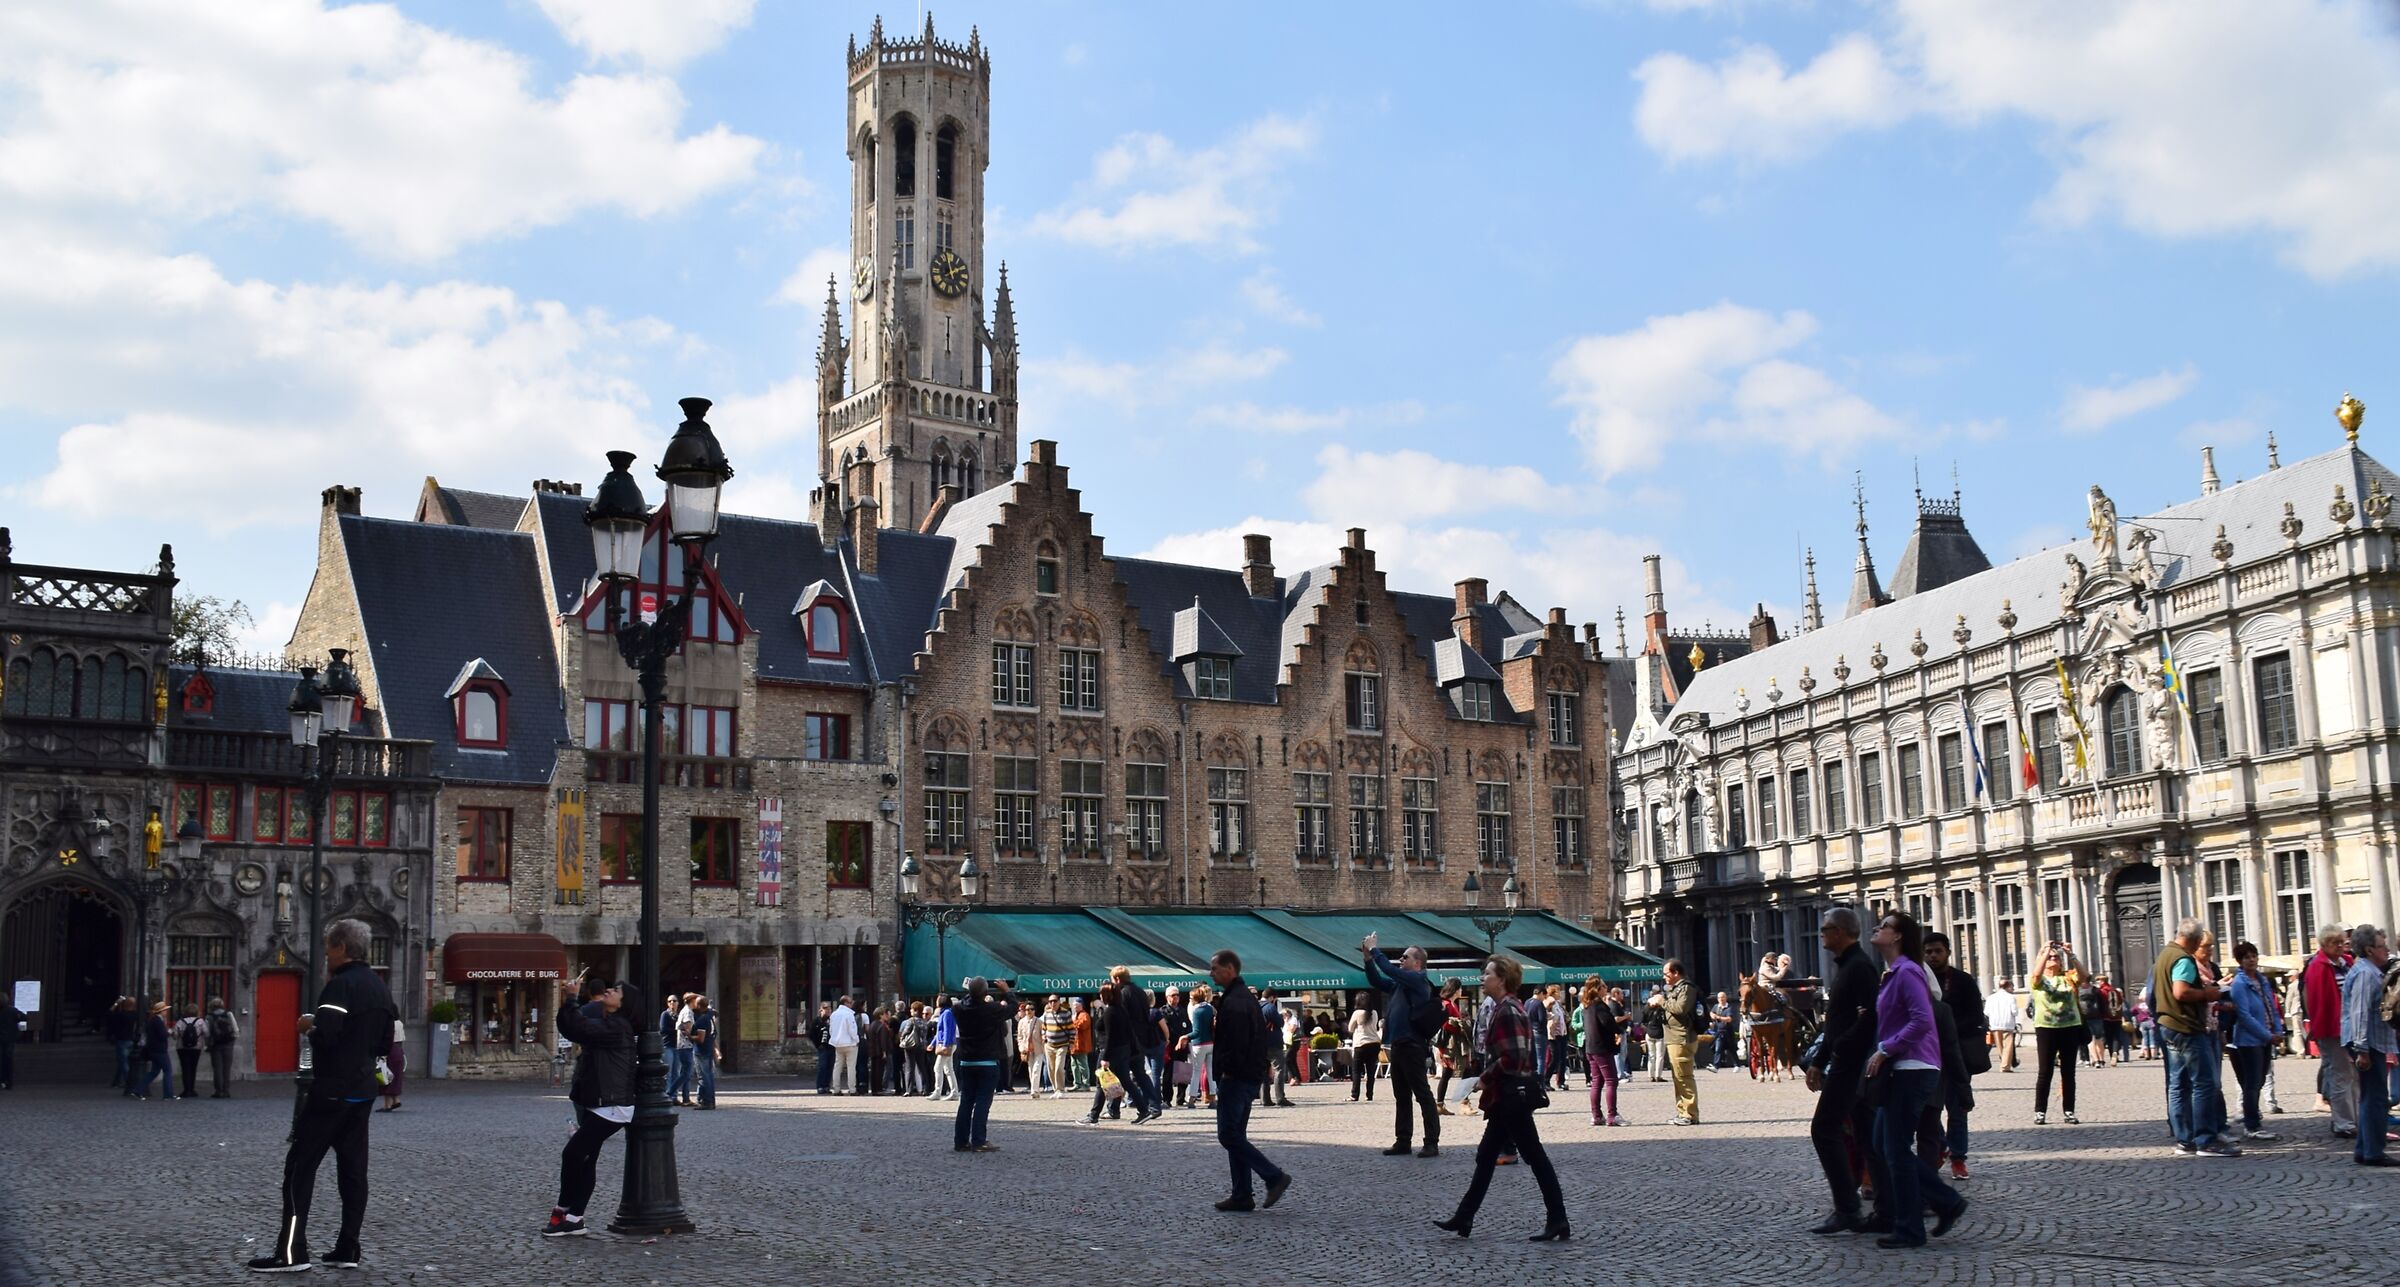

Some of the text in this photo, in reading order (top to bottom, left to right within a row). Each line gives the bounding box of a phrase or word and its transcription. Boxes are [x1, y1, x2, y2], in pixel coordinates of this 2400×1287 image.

[466, 970, 559, 979] CHOCOLATERIE DE BURG
[1618, 967, 1663, 978] TOM POUC
[1043, 978, 1071, 989] TOM
[1268, 977, 1347, 987] restaurant
